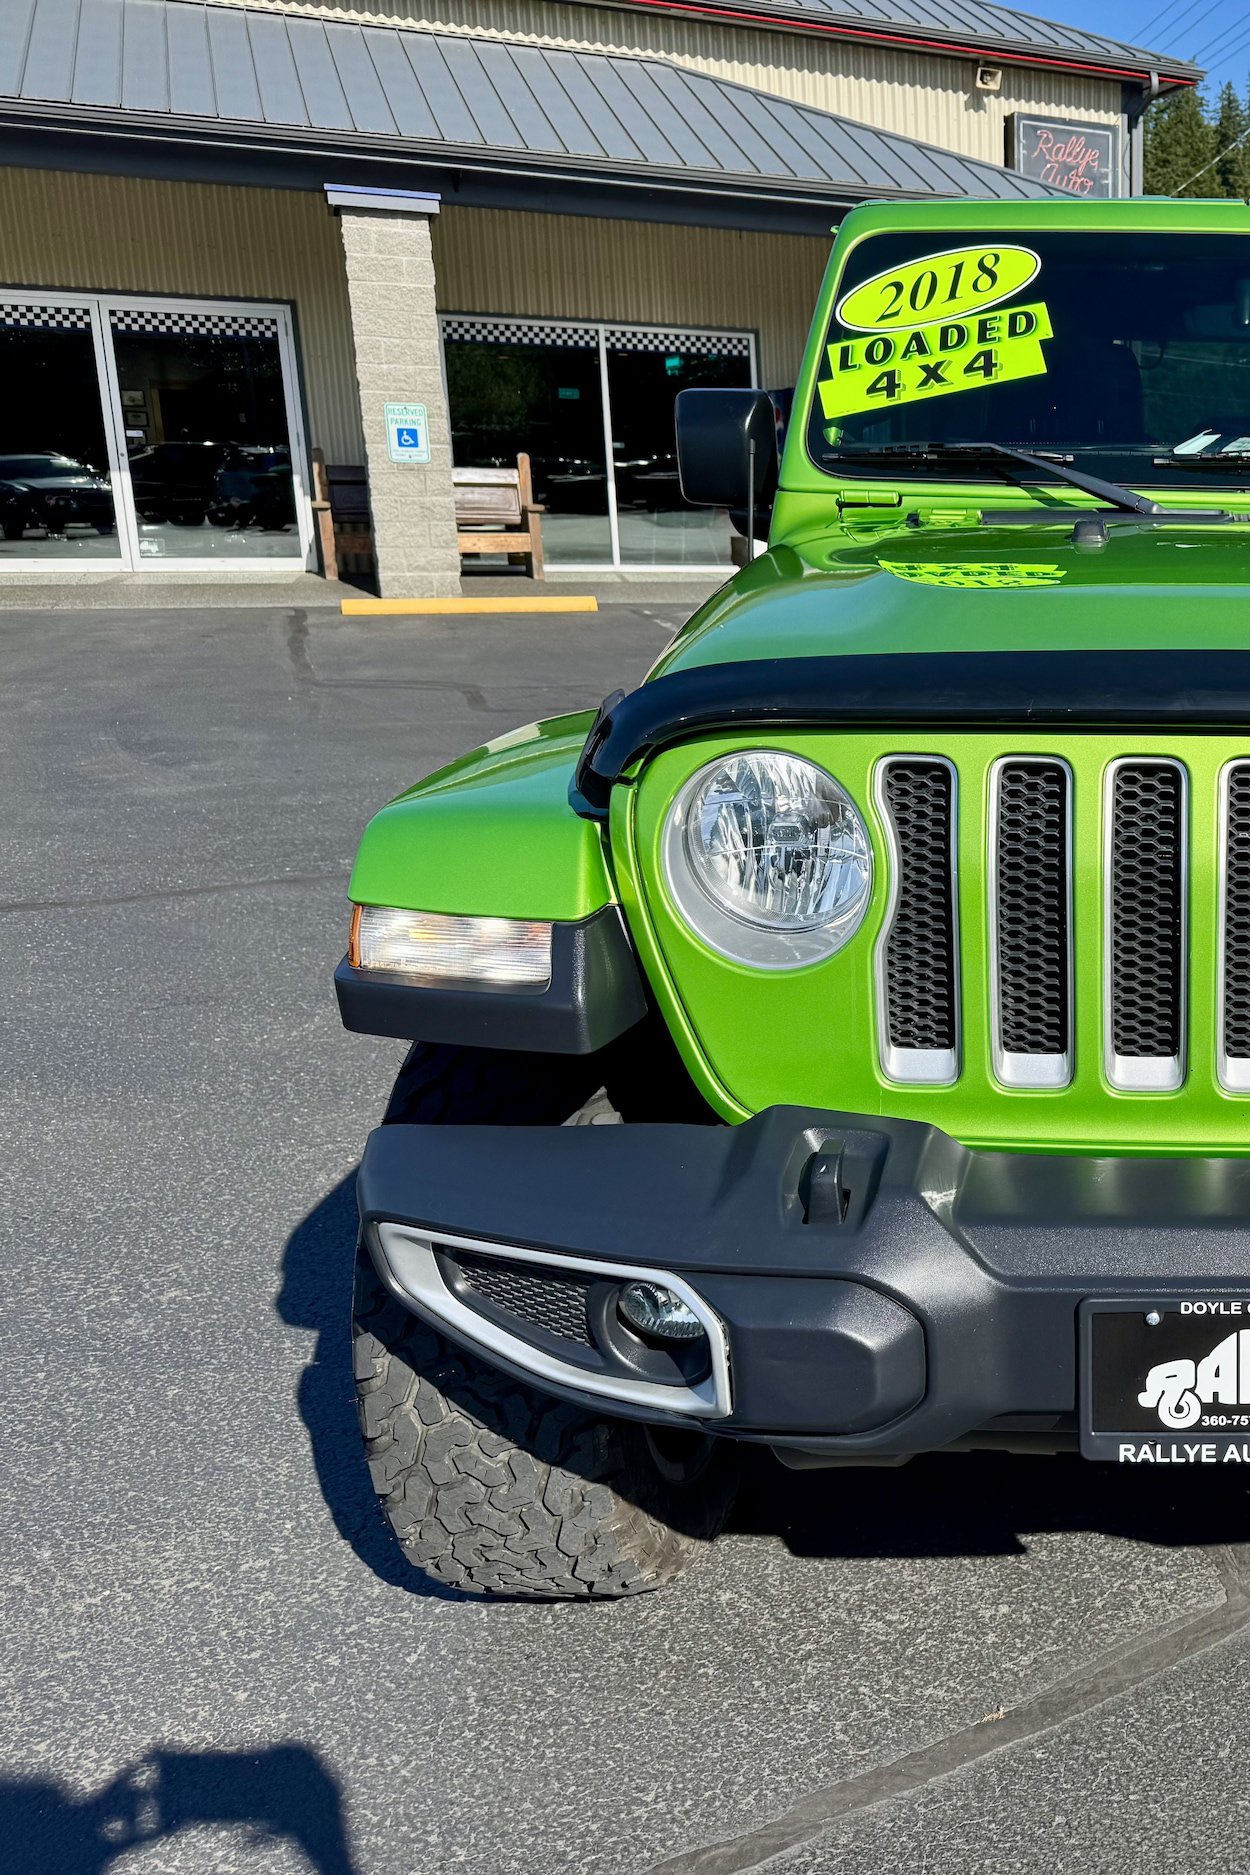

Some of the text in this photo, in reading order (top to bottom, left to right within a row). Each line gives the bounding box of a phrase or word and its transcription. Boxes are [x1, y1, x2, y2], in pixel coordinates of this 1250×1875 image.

[1032, 130, 1099, 176] Rallye
[875, 252, 1001, 322] 2018
[839, 311, 1037, 373] LOADED
[386, 408, 424, 417] RESERVED
[391, 417, 421, 426] PARKING
[1180, 1301, 1242, 1315] DOYLE
[1119, 1443, 1216, 1463] RALLYE
